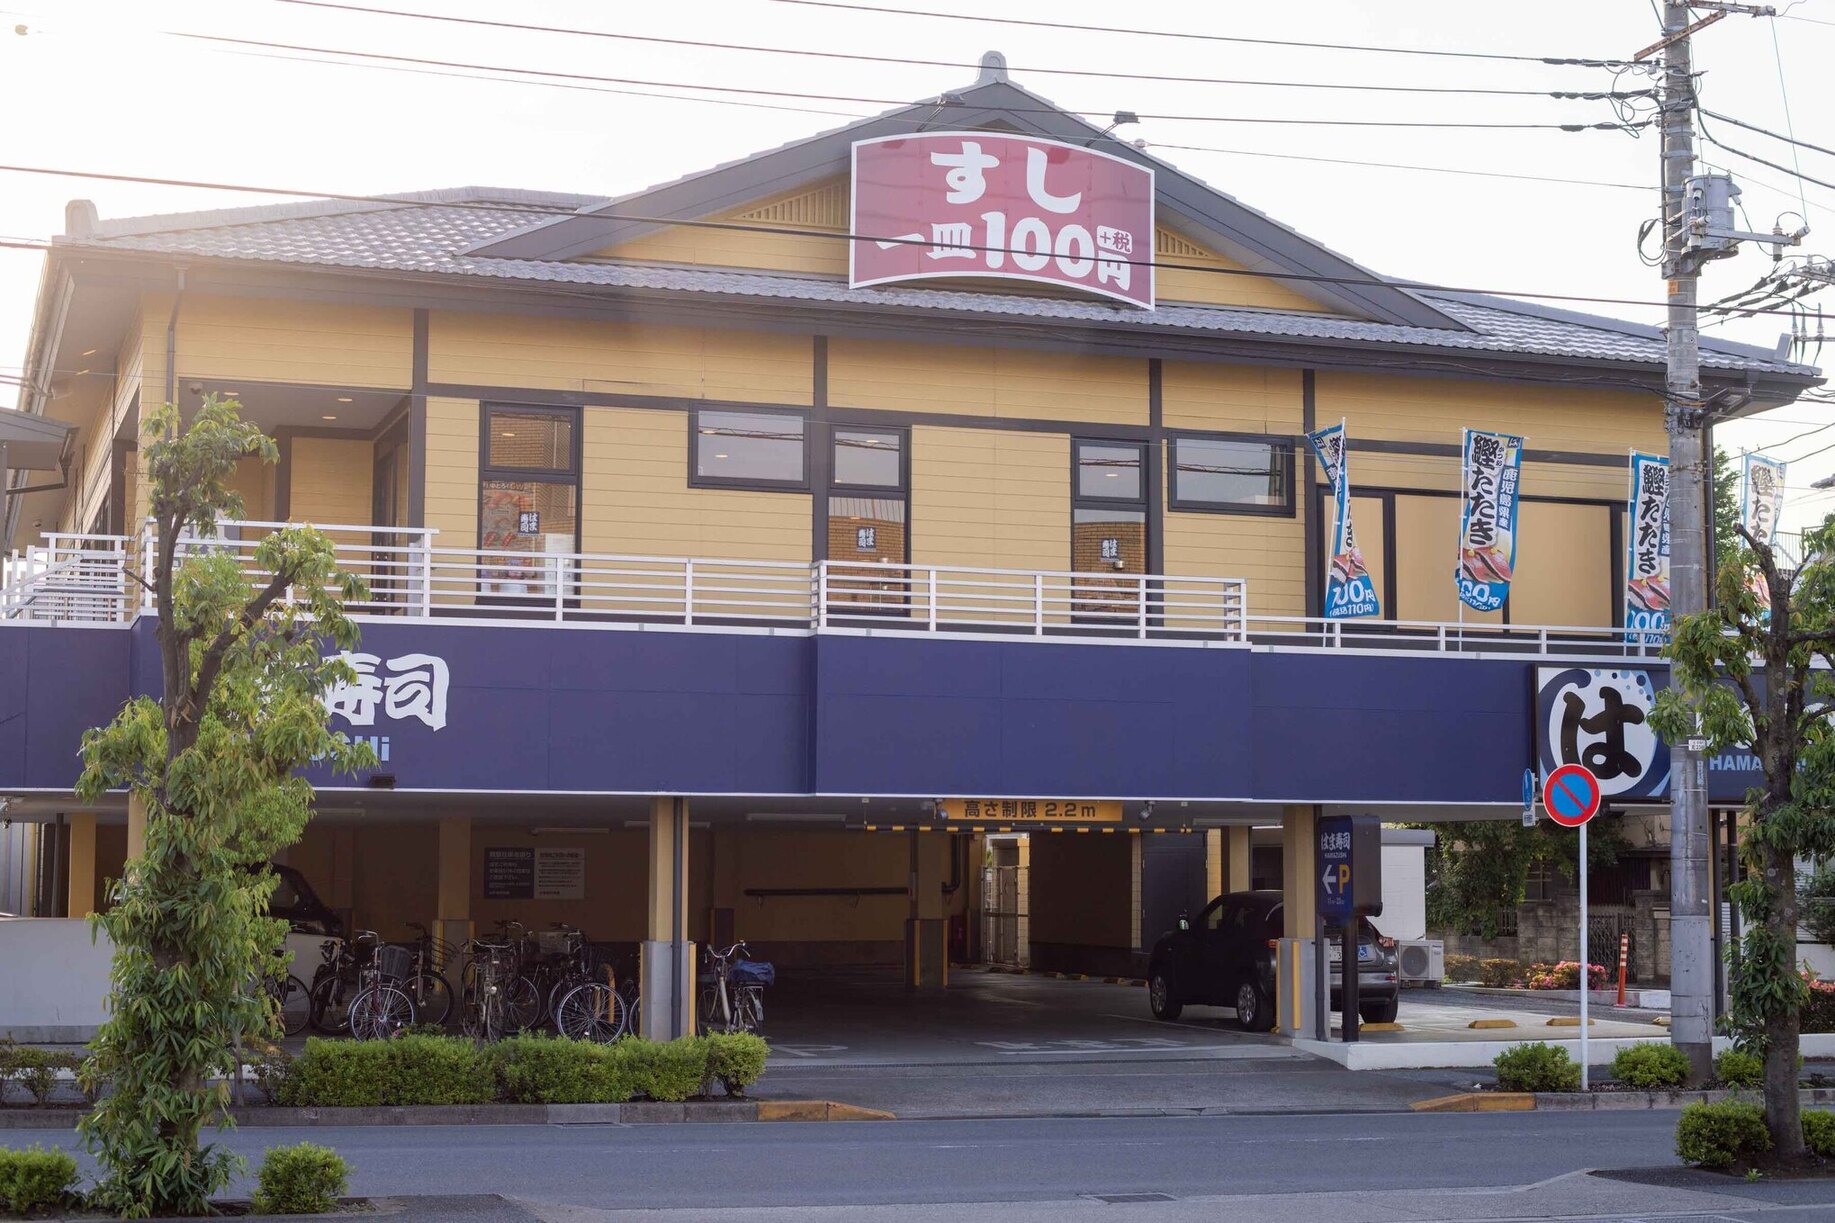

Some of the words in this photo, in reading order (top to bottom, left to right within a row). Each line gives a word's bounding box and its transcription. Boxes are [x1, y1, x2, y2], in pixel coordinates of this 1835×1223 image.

[930, 141, 1082, 214] すし
[876, 211, 1131, 291] 一皿100円
[1470, 434, 1499, 546] 鰹たたき
[1638, 464, 1666, 575] 鰹たたき
[1560, 686, 1645, 780] は
[964, 800, 1037, 818] 高さ制限
[1045, 802, 1097, 817] 2.2m
[1320, 832, 1351, 851] はま寿司
[1338, 863, 1351, 894] P
